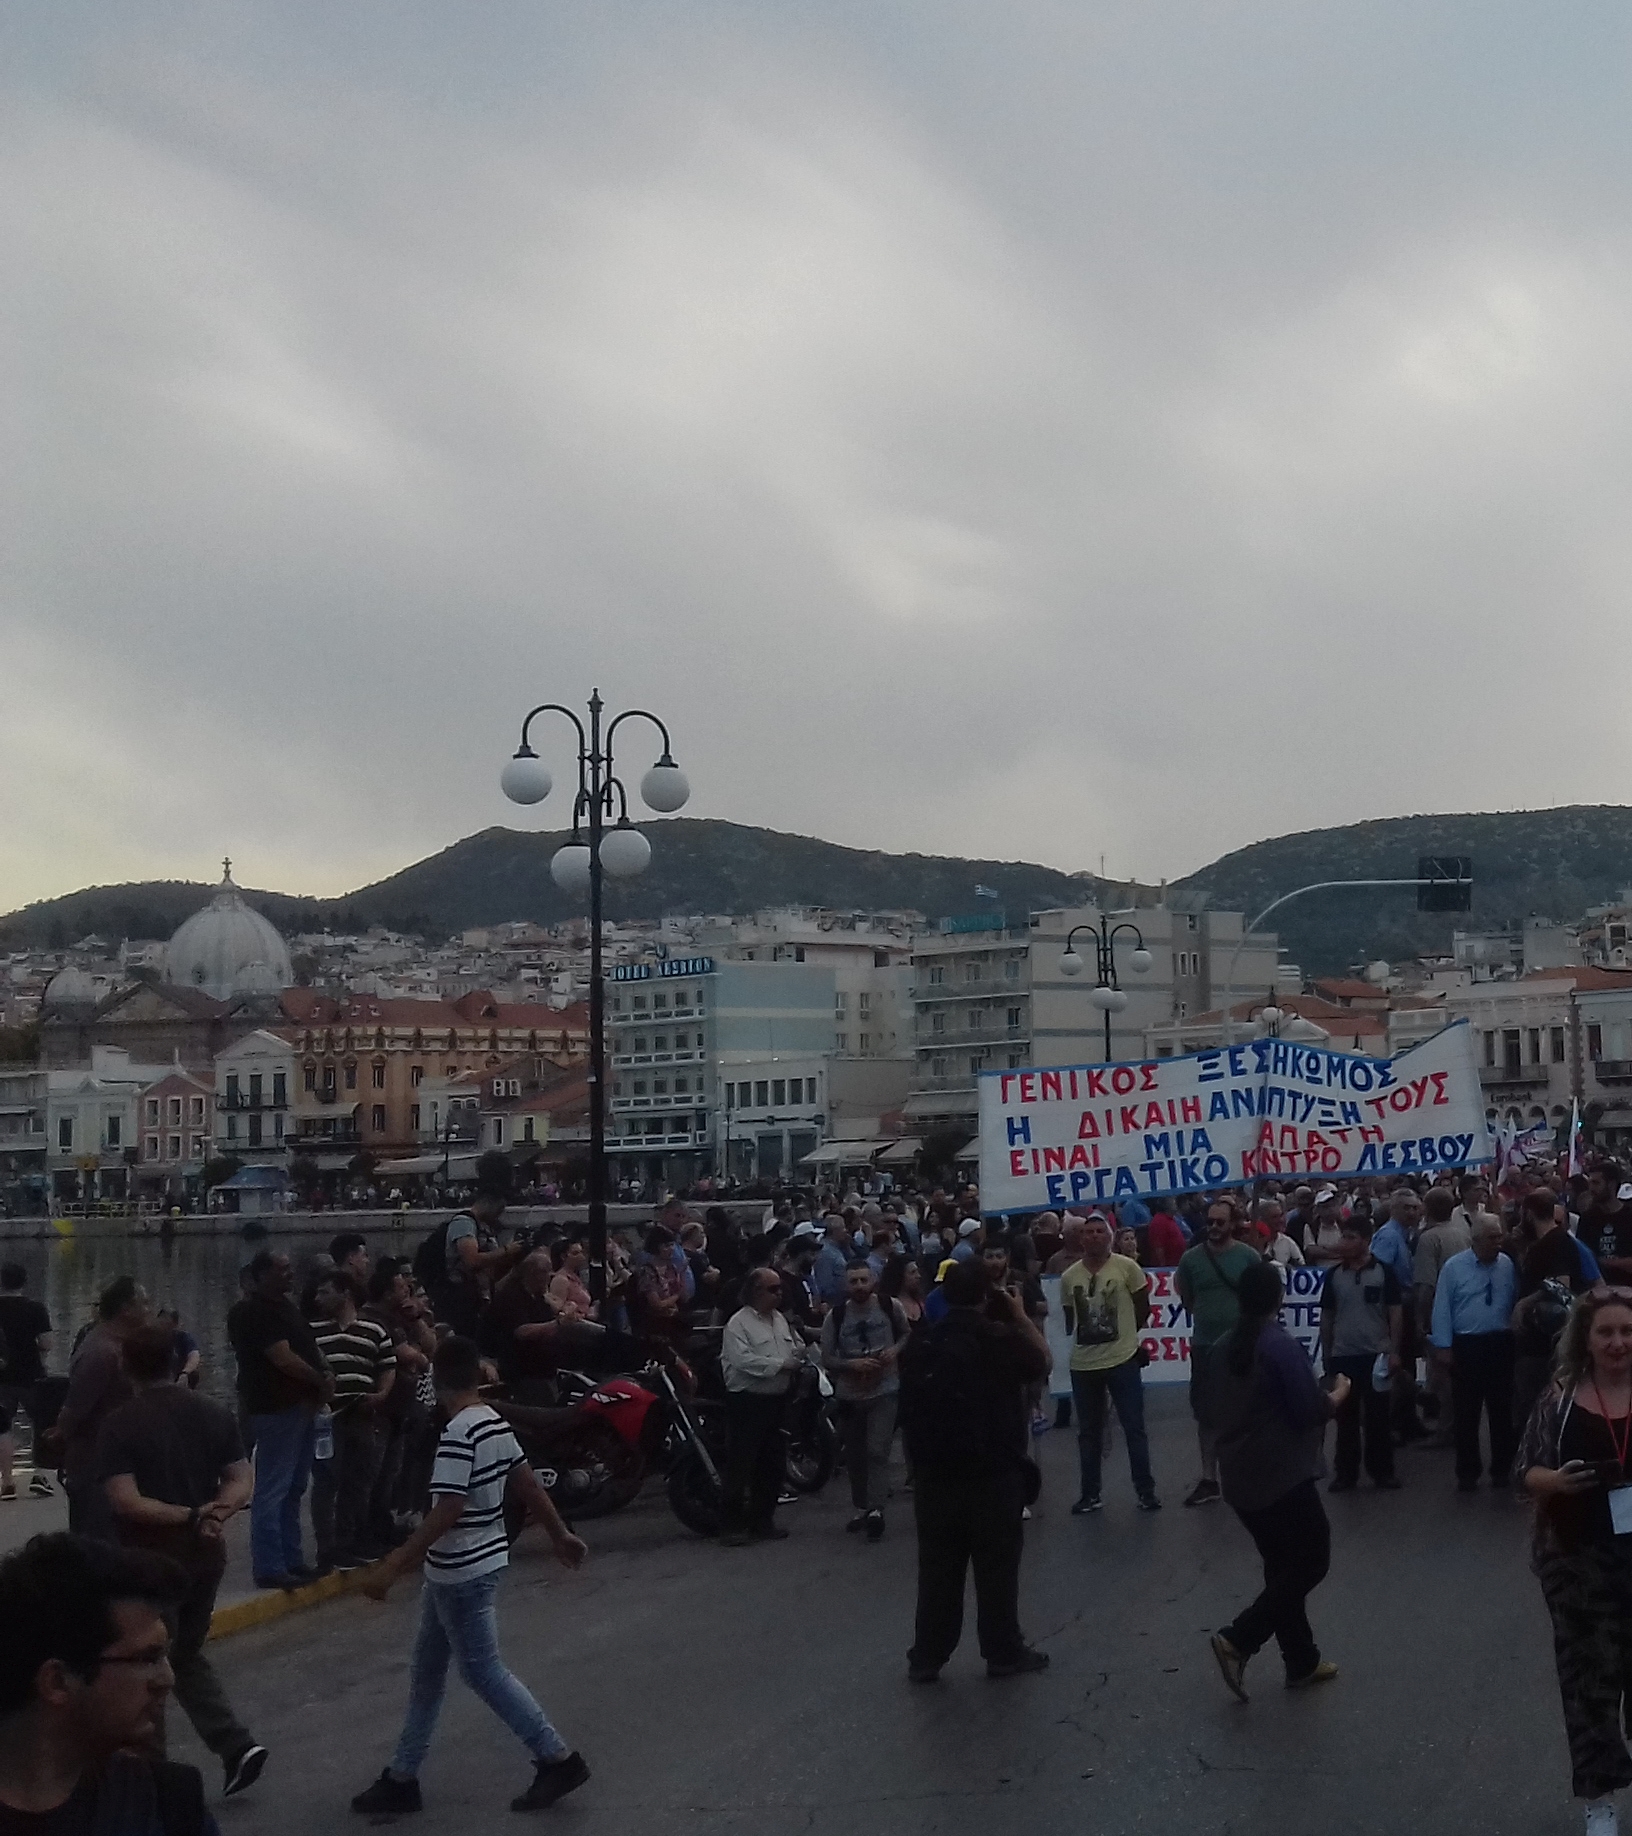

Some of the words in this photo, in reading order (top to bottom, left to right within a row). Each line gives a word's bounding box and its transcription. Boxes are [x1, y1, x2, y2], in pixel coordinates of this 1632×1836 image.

[1001, 1064, 1158, 1104] ΓΕΝΙΚΟΣ
[1197, 1042, 1398, 1092] ΞΕΣΗΚΩΜΟΣ
[1007, 1116, 1032, 1146] Η
[1078, 1095, 1203, 1139] ΔΙΚΑΙΗ
[1365, 1071, 1449, 1119] ΤΟΥΣ
[1010, 1144, 1100, 1177] ΕΙΝΑΙ
[1144, 1128, 1212, 1160] ΜΙΑ
[1258, 1120, 1384, 1150] ΑΠΑΤΗ
[1046, 1154, 1230, 1206] ΕΡΓΑΤΙΚΟ
[1241, 1147, 1342, 1179] ΚΝΤΡΟ
[1357, 1133, 1474, 1172] ΛΕΣΒΟΥ
